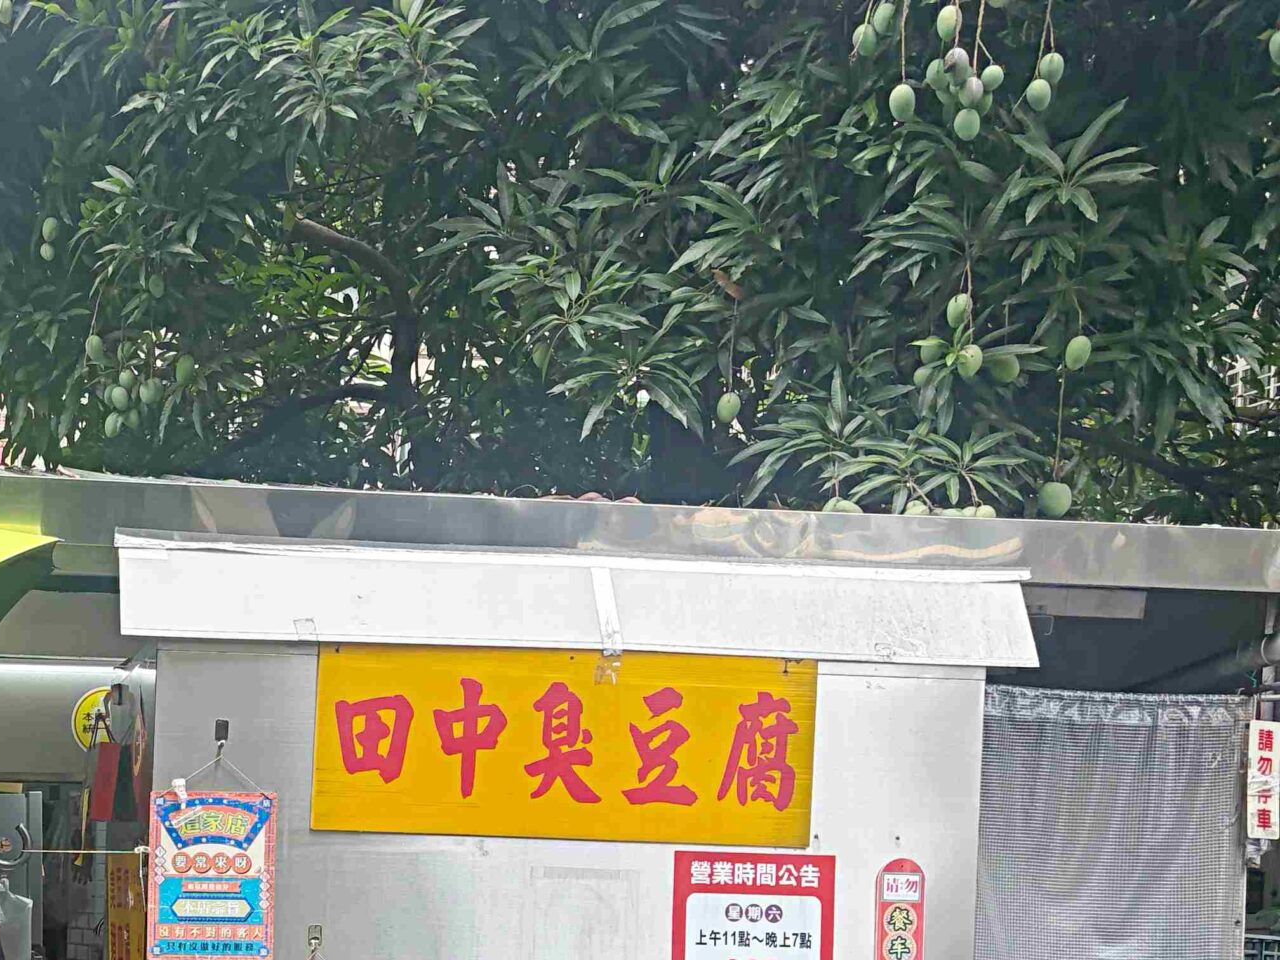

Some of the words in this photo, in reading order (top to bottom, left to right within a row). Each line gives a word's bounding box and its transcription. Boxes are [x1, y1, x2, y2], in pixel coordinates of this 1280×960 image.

[334, 677, 799, 811] 田中臭豆腐
[690, 860, 821, 888] 營業時間公告
[727, 904, 782, 922] 星期六
